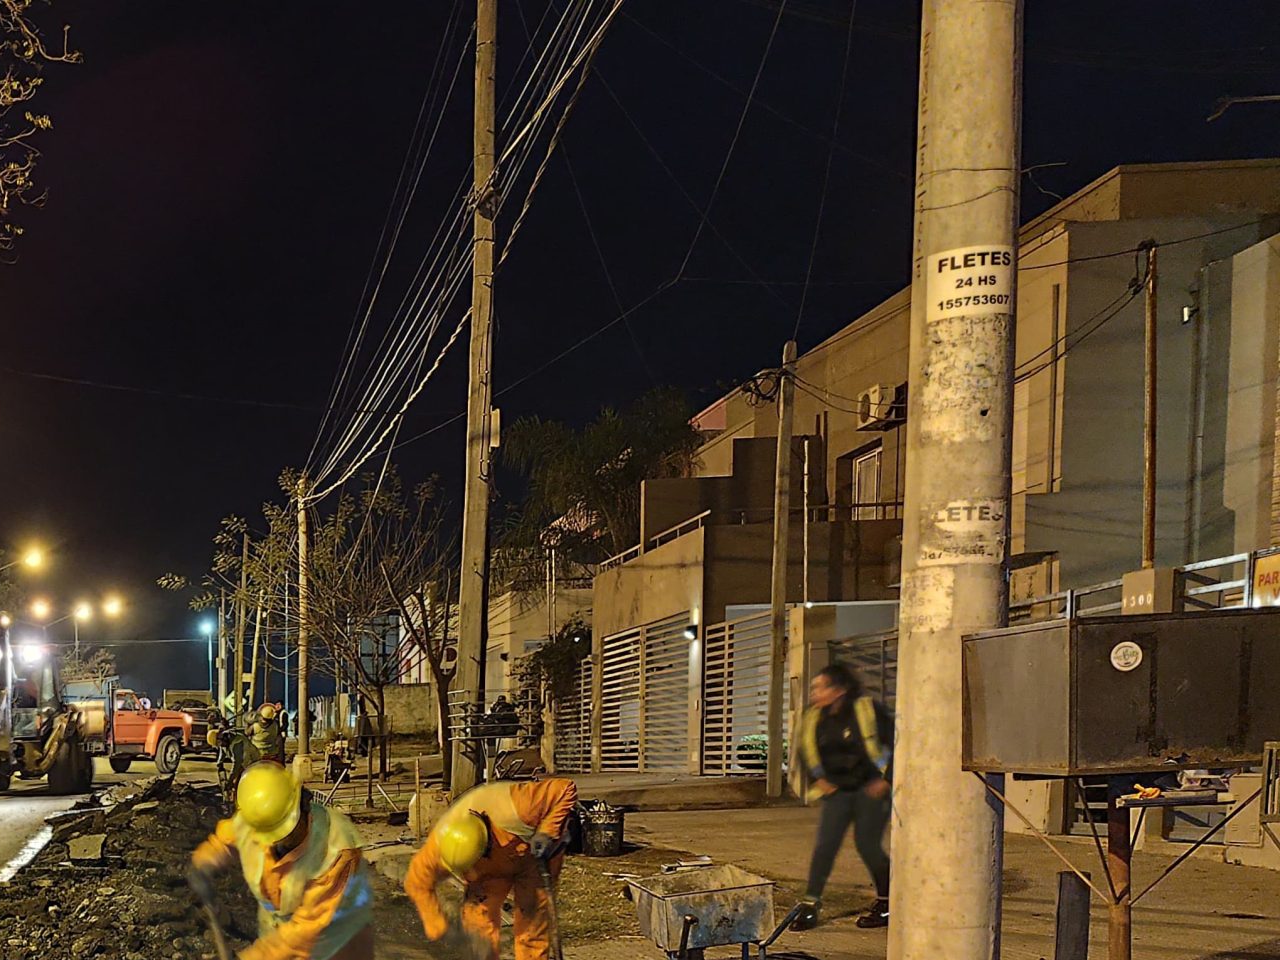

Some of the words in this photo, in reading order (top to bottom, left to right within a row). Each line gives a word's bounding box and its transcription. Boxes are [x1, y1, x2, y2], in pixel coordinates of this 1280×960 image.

[937, 251, 1011, 273] FLETES
[955, 276, 973, 289] 24
[978, 275, 997, 286] HS
[937, 294, 1010, 311] 155753607
